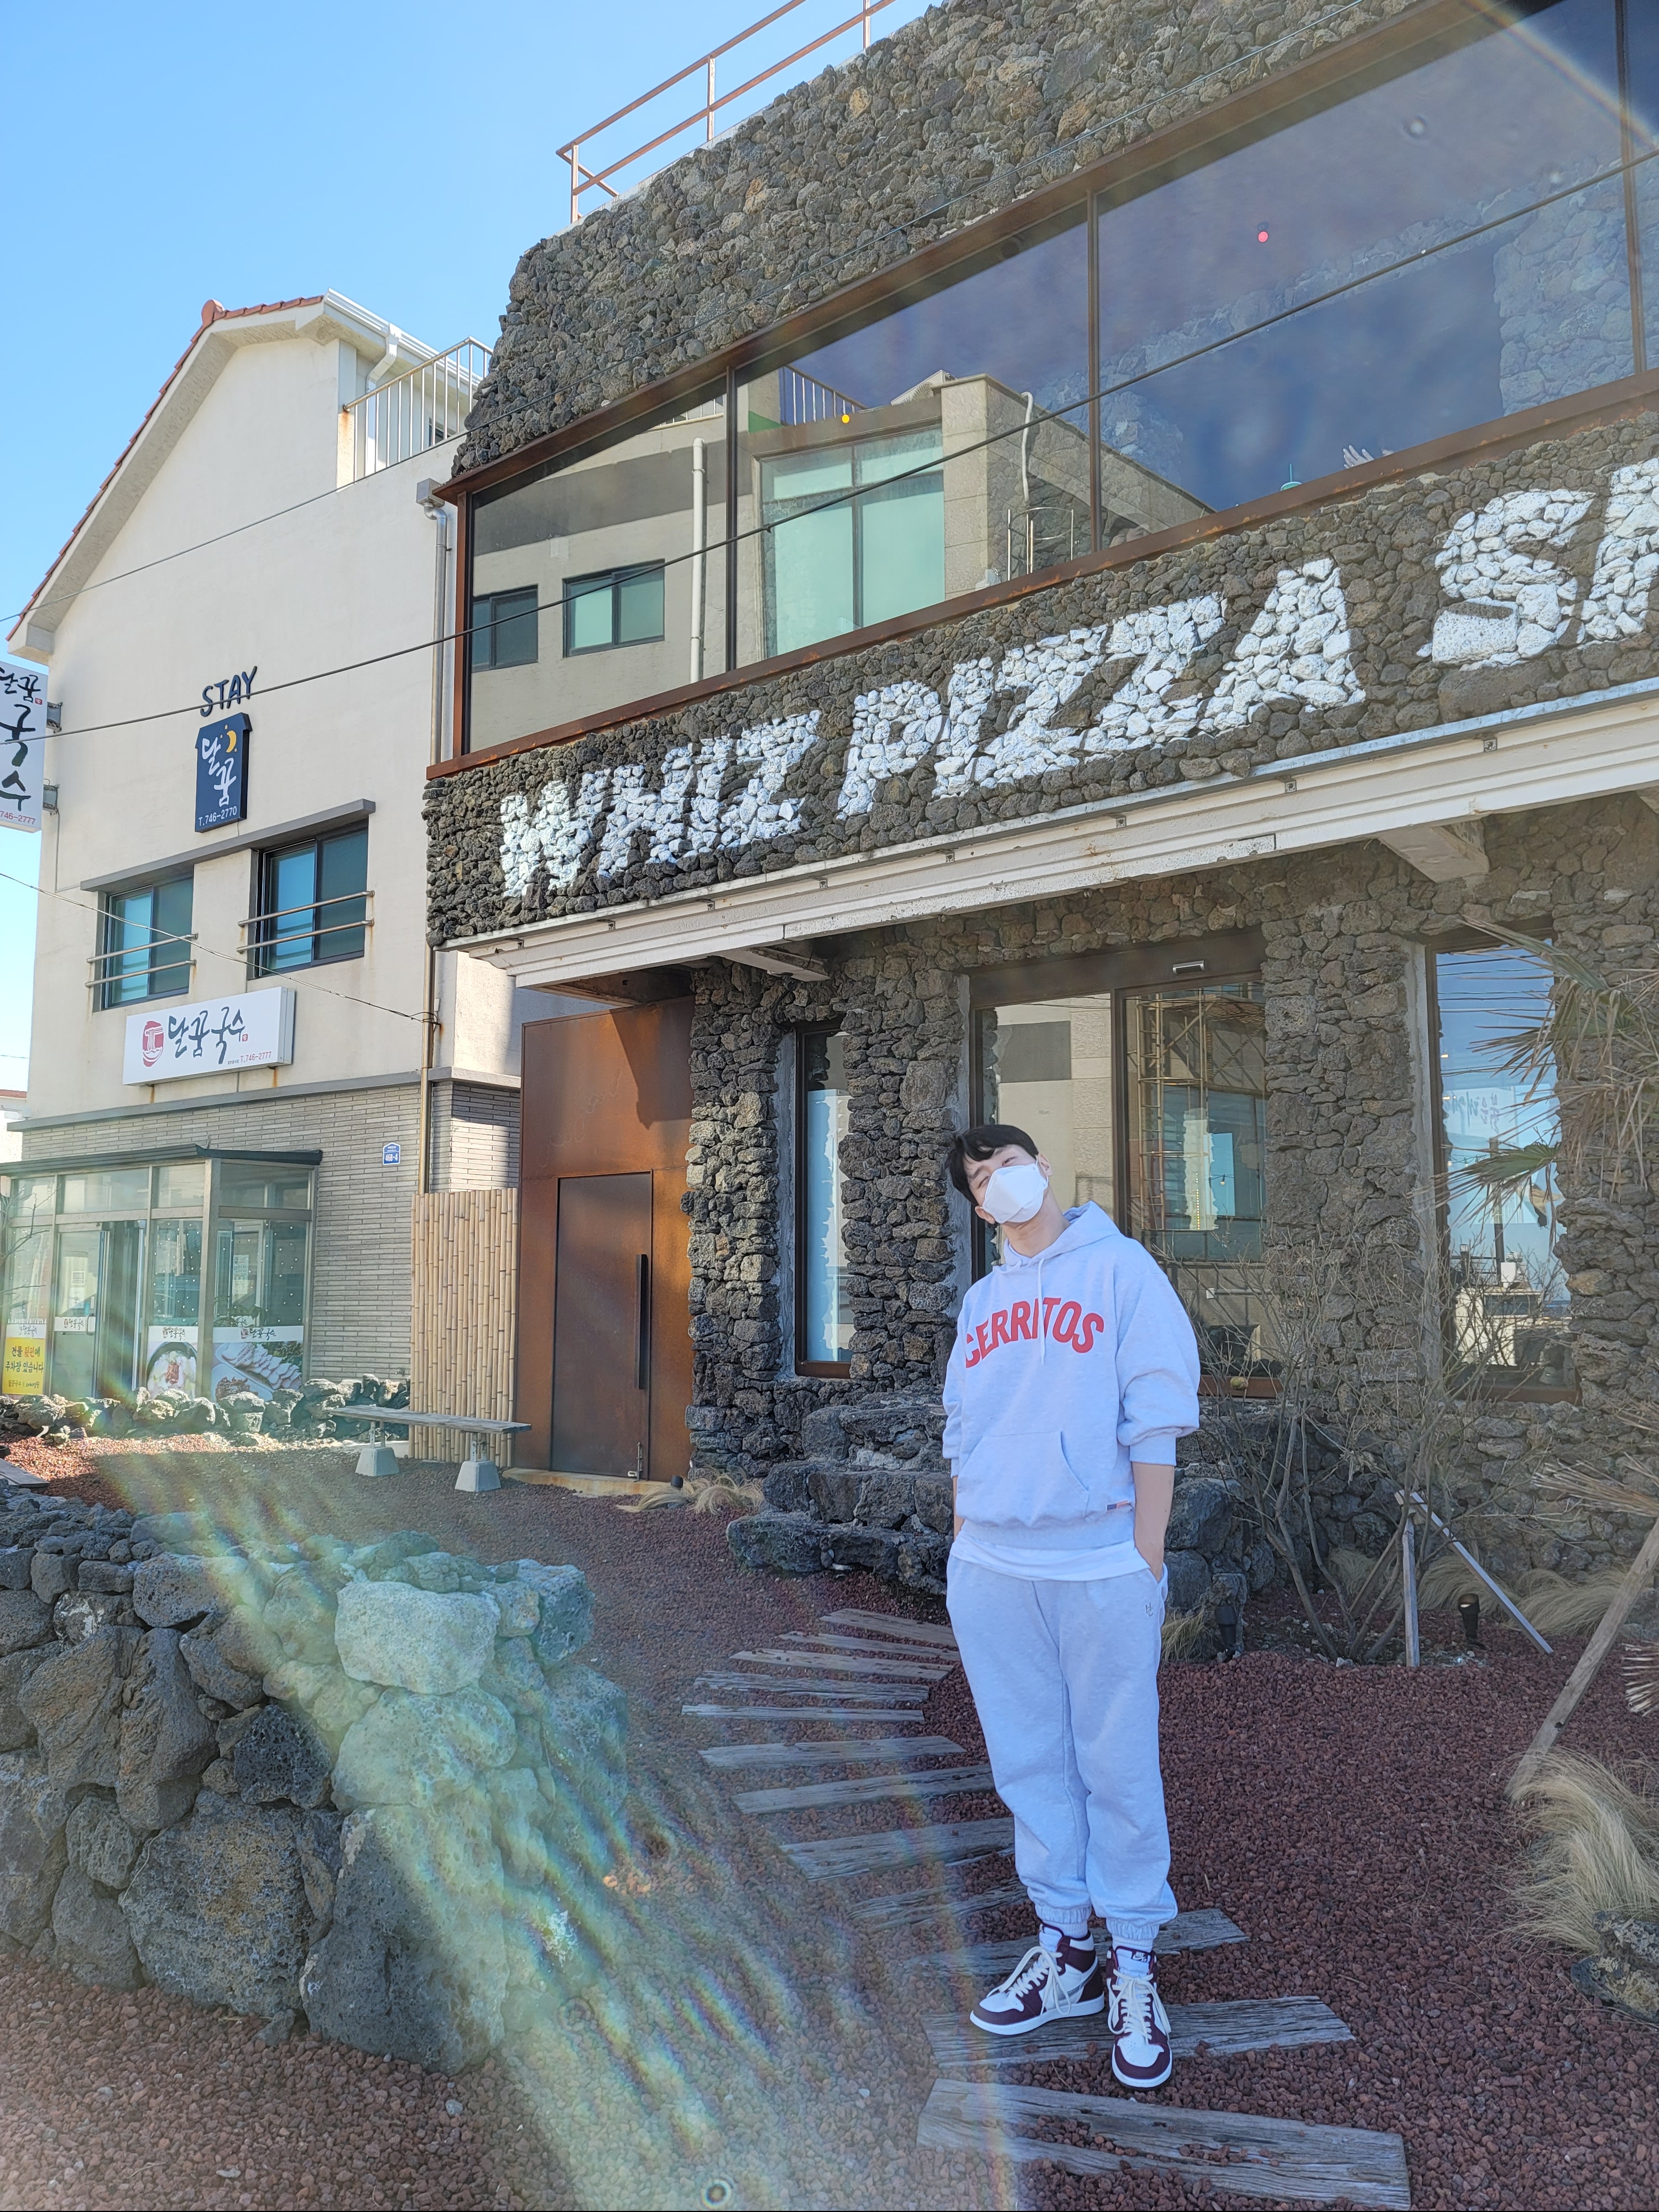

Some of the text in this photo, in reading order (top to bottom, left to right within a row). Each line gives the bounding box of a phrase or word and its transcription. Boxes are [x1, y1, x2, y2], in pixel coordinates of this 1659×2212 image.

[200, 666, 257, 717] STAY
[837, 557, 1366, 822] PIZZA
[202, 737, 237, 807] 달꿈
[198, 806, 237, 827] T.746-2770
[168, 1006, 246, 1065] 달꿈국수
[240, 1051, 272, 1063] T.746-2777
[12, 1345, 23, 1358] 건물
[965, 1297, 1104, 1369] CERRITOS
[5, 1360, 44, 1374] 주차장 있습니다
